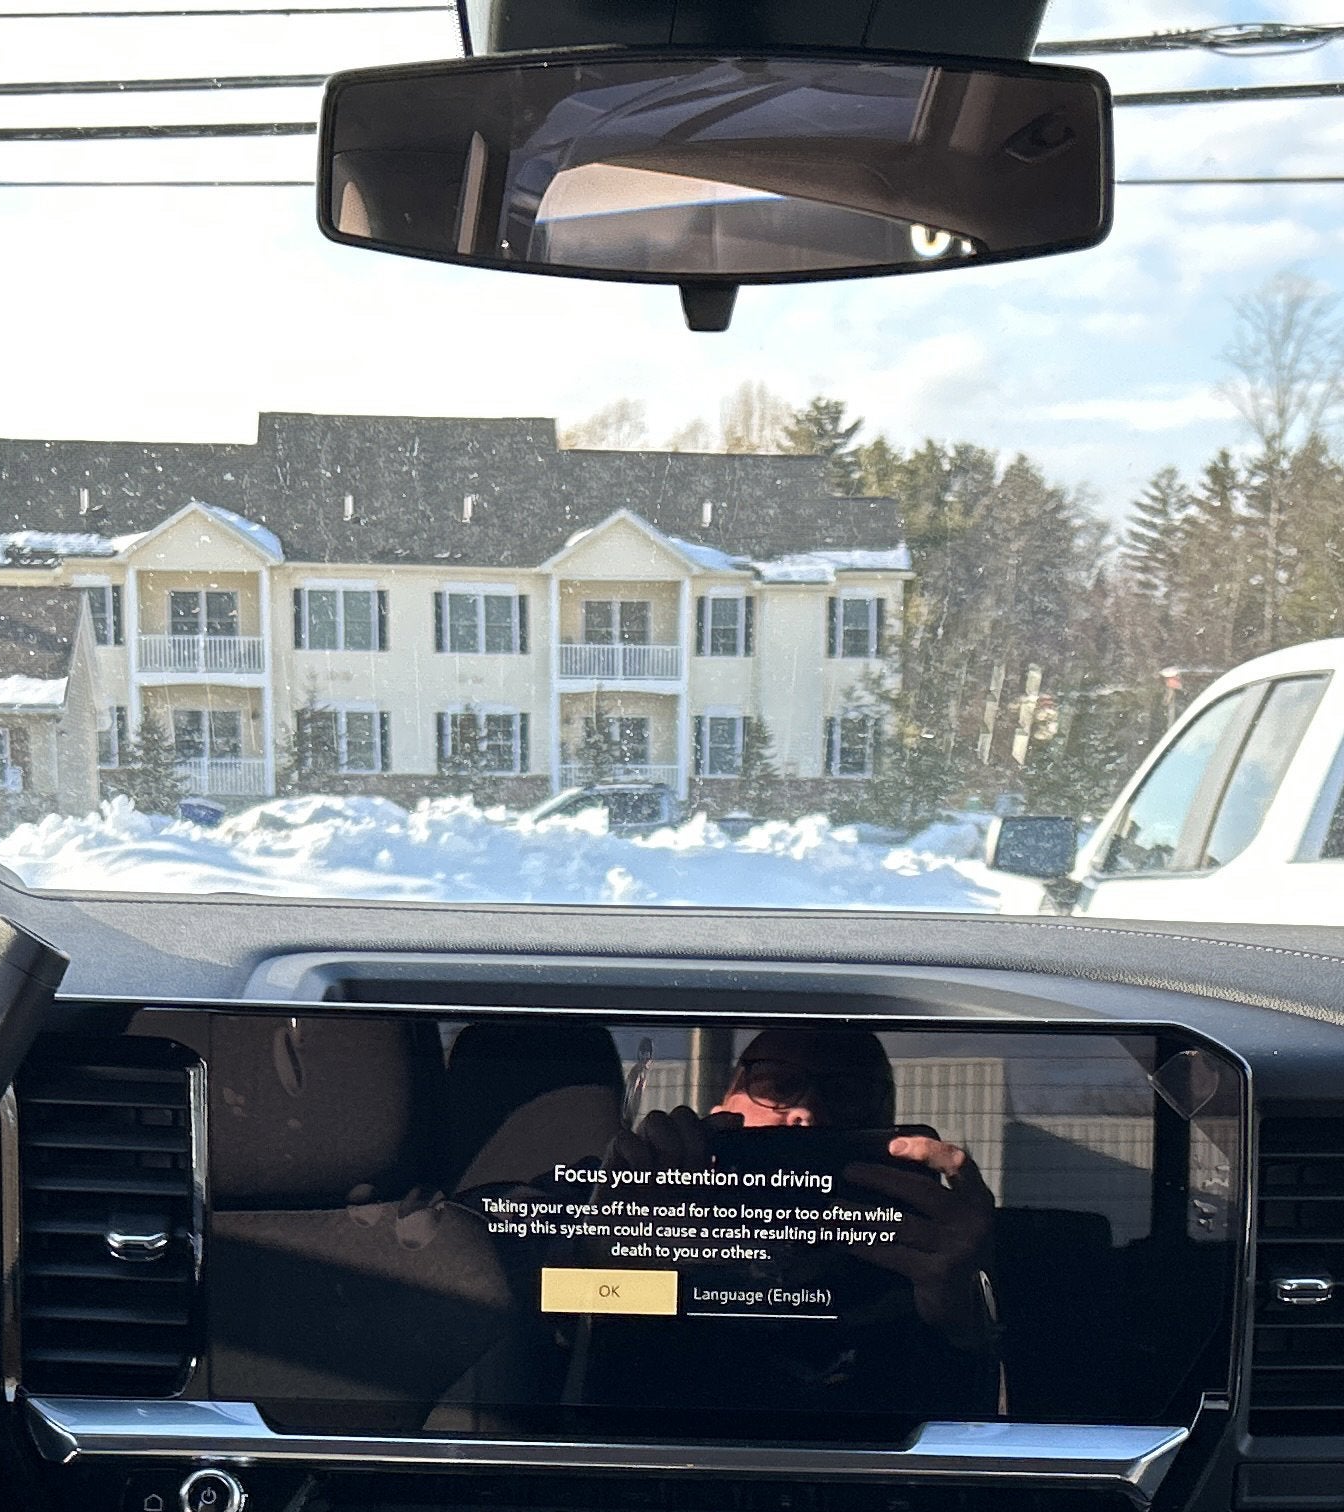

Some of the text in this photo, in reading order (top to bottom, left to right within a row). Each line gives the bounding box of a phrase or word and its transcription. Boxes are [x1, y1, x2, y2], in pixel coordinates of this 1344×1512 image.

[555, 1165, 832, 1193] Focus your attention on driving
[482, 1198, 902, 1222] Taking your eyes off the road for too long or too often while
[489, 1220, 895, 1245] using this system could cause a crash resulting in injury or
[612, 1242, 770, 1261] death to you or others.
[599, 1285, 620, 1297] OK
[694, 1288, 831, 1306] Language (English)
